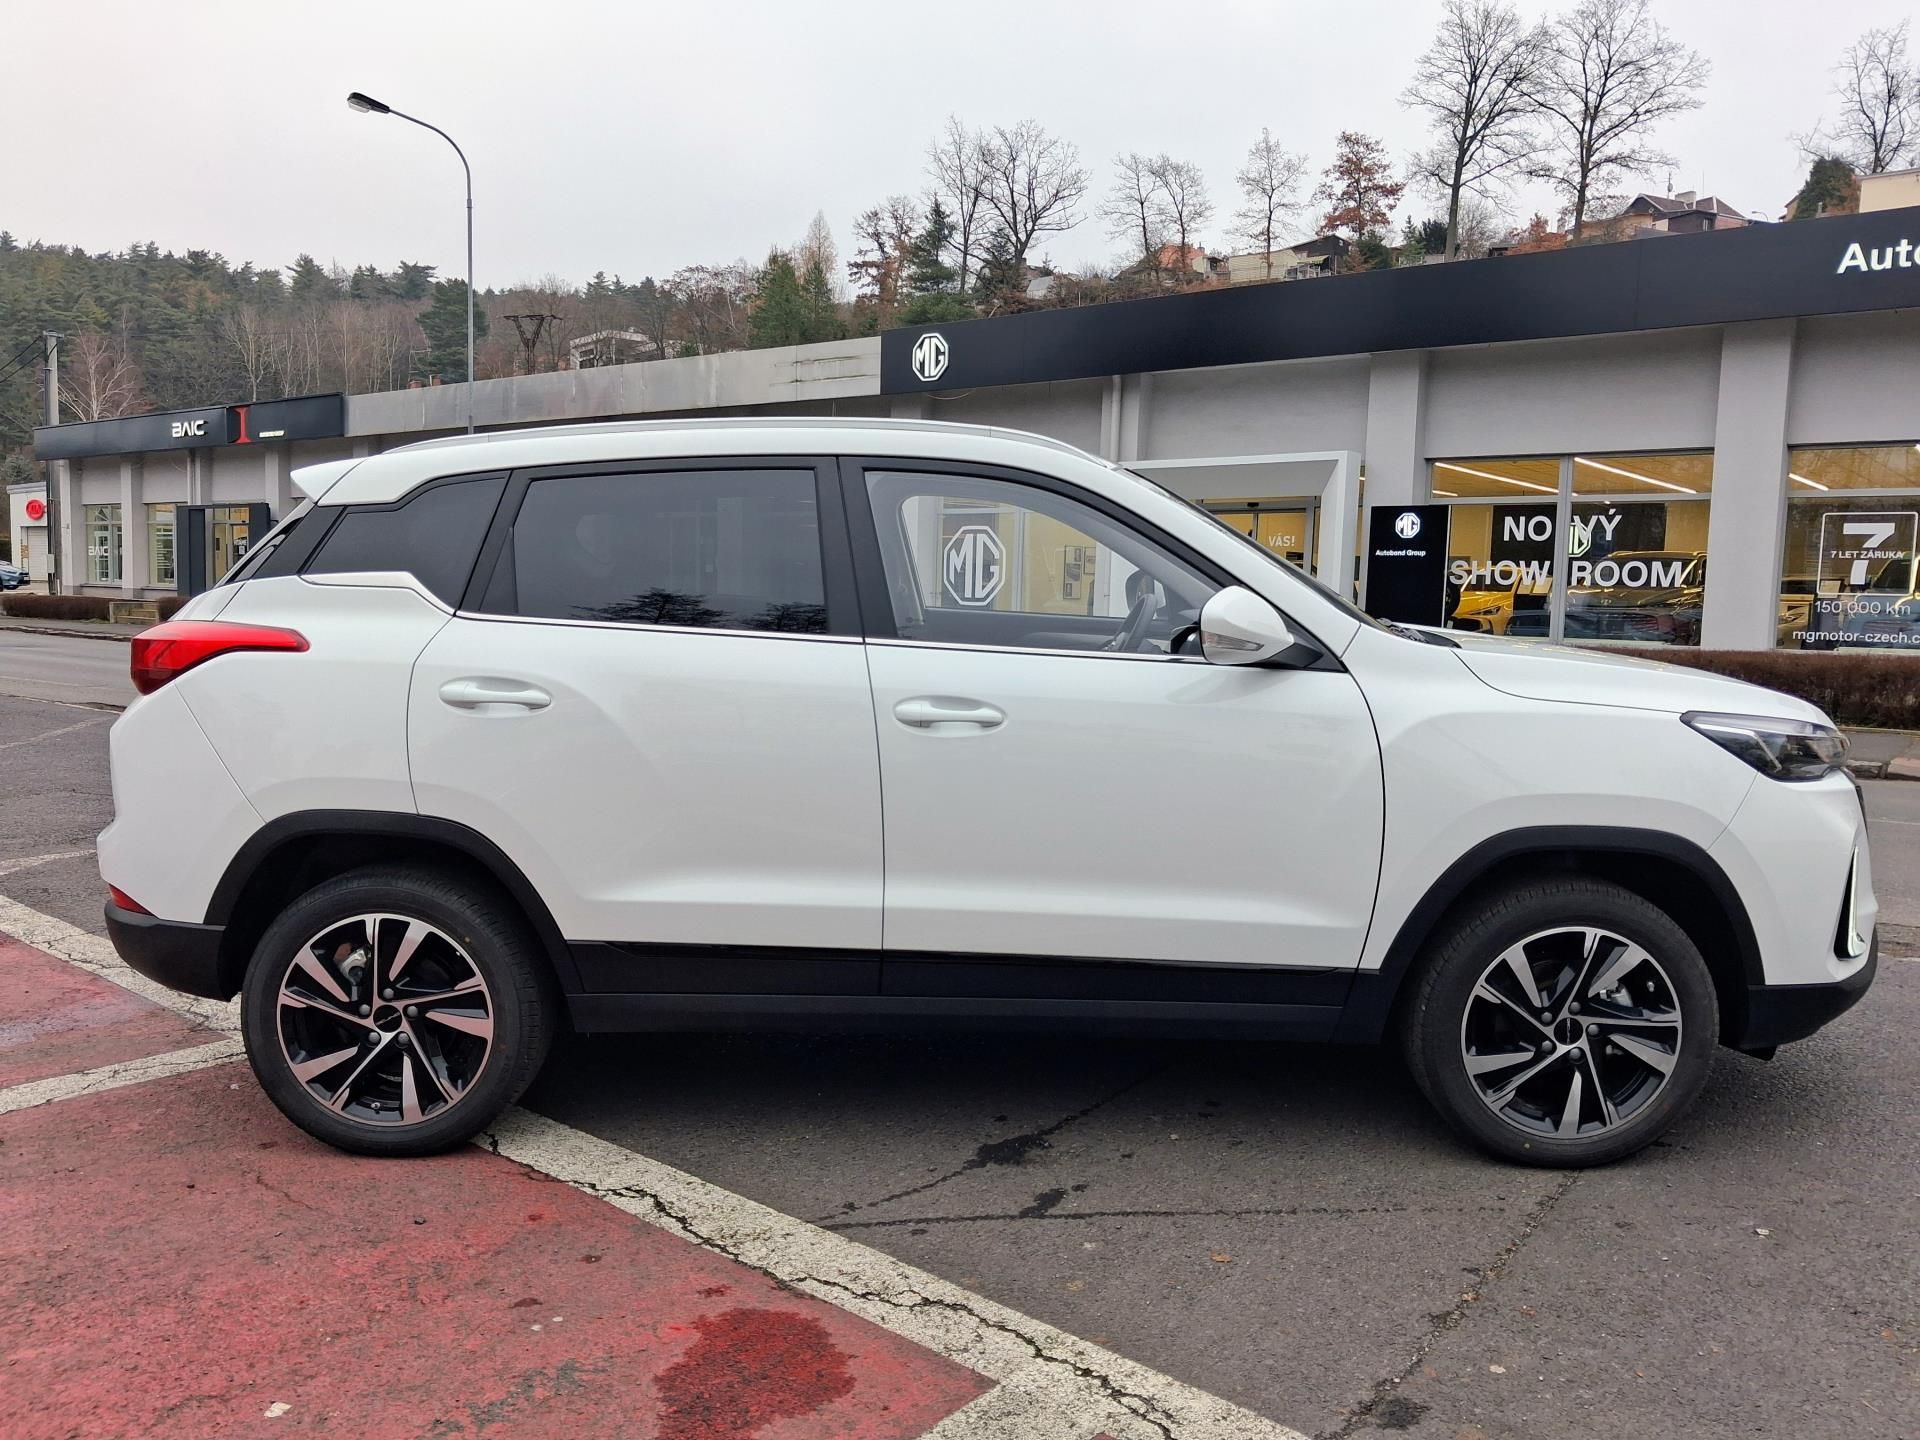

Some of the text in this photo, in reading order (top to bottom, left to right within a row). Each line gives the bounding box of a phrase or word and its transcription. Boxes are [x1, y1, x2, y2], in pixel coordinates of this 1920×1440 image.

[914, 336, 945, 378] MG
[171, 420, 205, 438] BAIC
[1396, 514, 1419, 536] MG
[1268, 533, 1296, 547] VÁS!
[1406, 549, 1426, 557] Group
[1830, 551, 1837, 559] 7
[1838, 551, 1859, 559] LET
[1842, 522, 1895, 585] 7
[949, 533, 1001, 599] MG
[1814, 601, 1911, 615] 150 000 km
